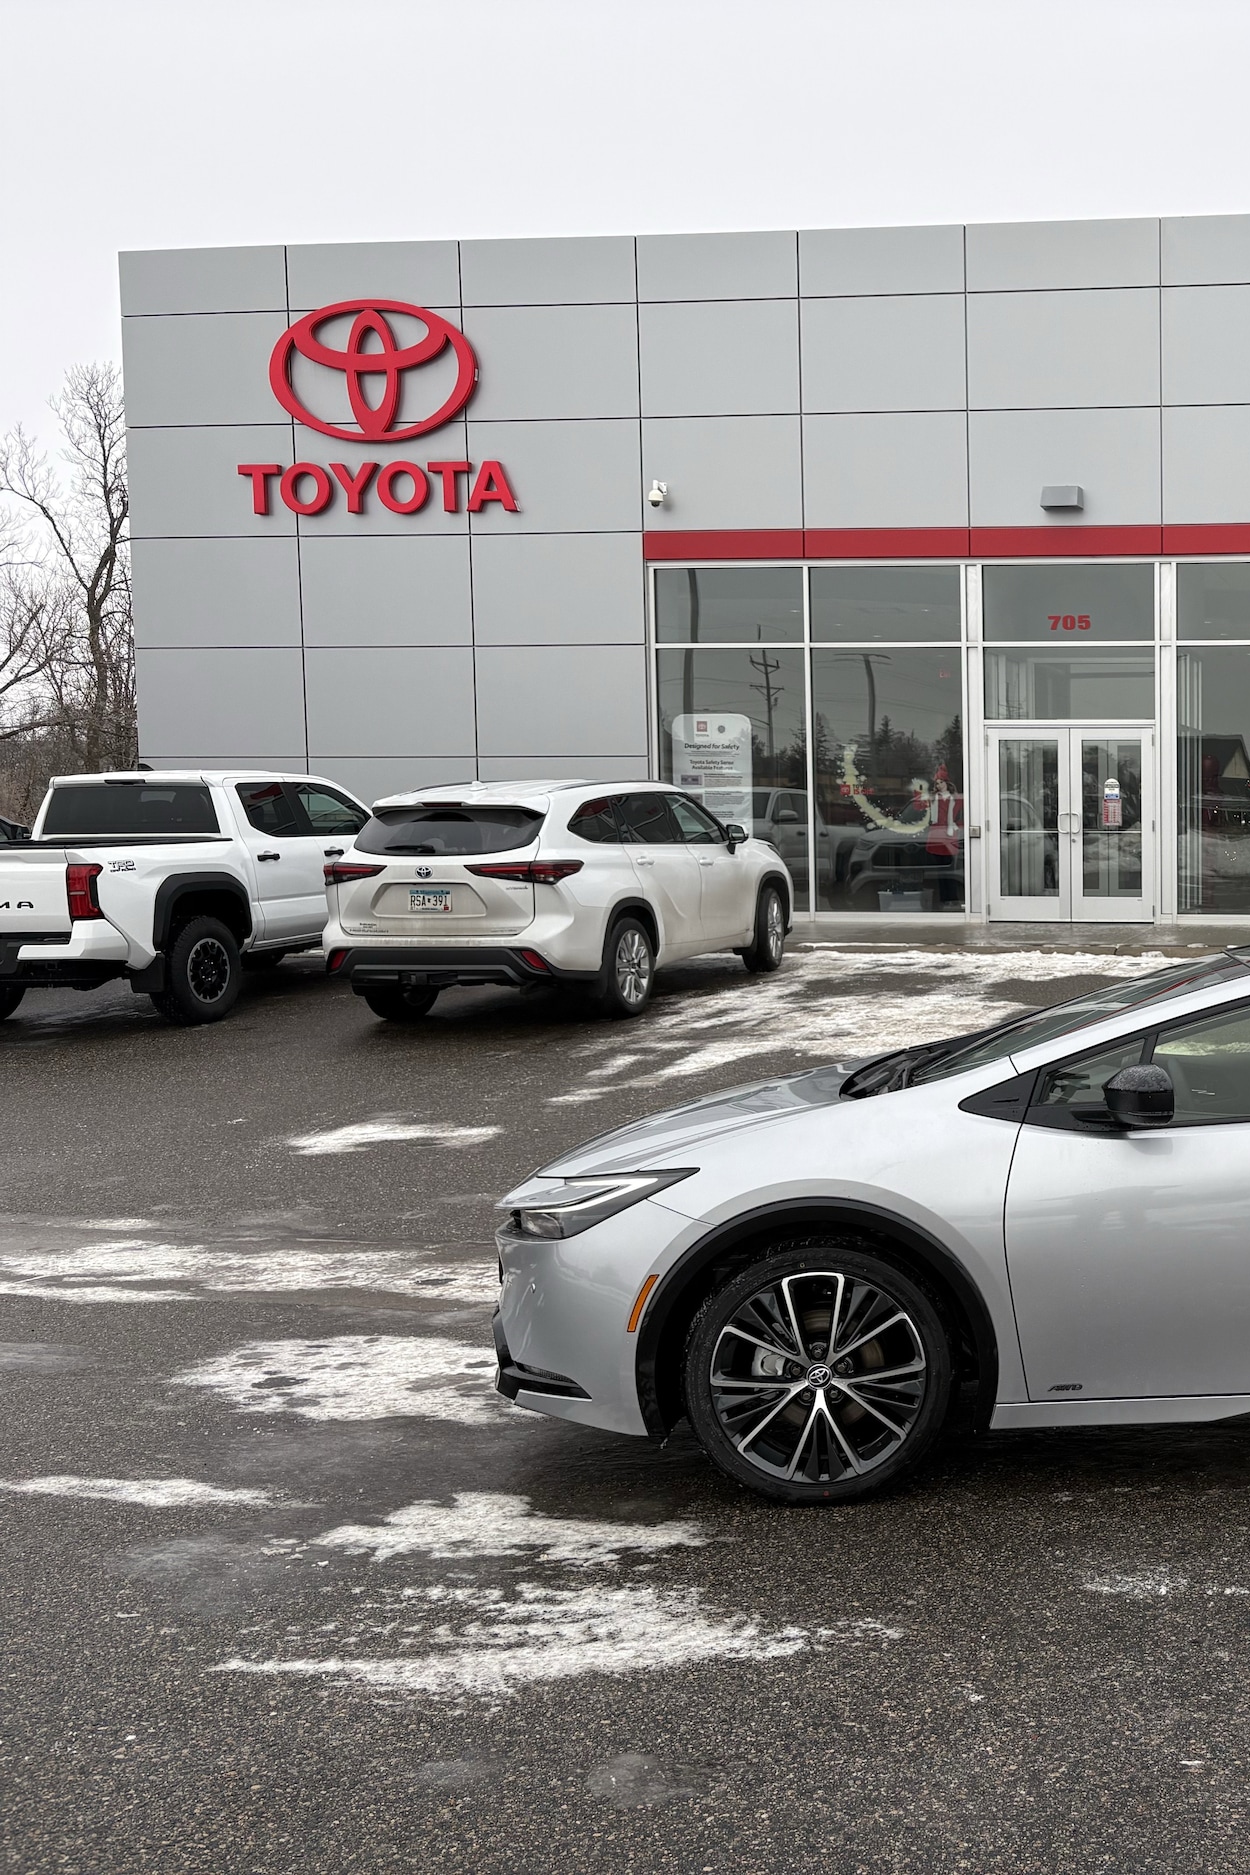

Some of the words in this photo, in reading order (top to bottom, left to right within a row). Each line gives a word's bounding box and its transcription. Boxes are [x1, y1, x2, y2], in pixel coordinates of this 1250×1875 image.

[237, 460, 521, 515] TOYOTA
[1047, 614, 1092, 631] 705
[721, 743, 740, 751] Safety
[410, 895, 426, 907] RSA
[432, 895, 448, 906] 391
[1047, 1383, 1083, 1392] AWD
